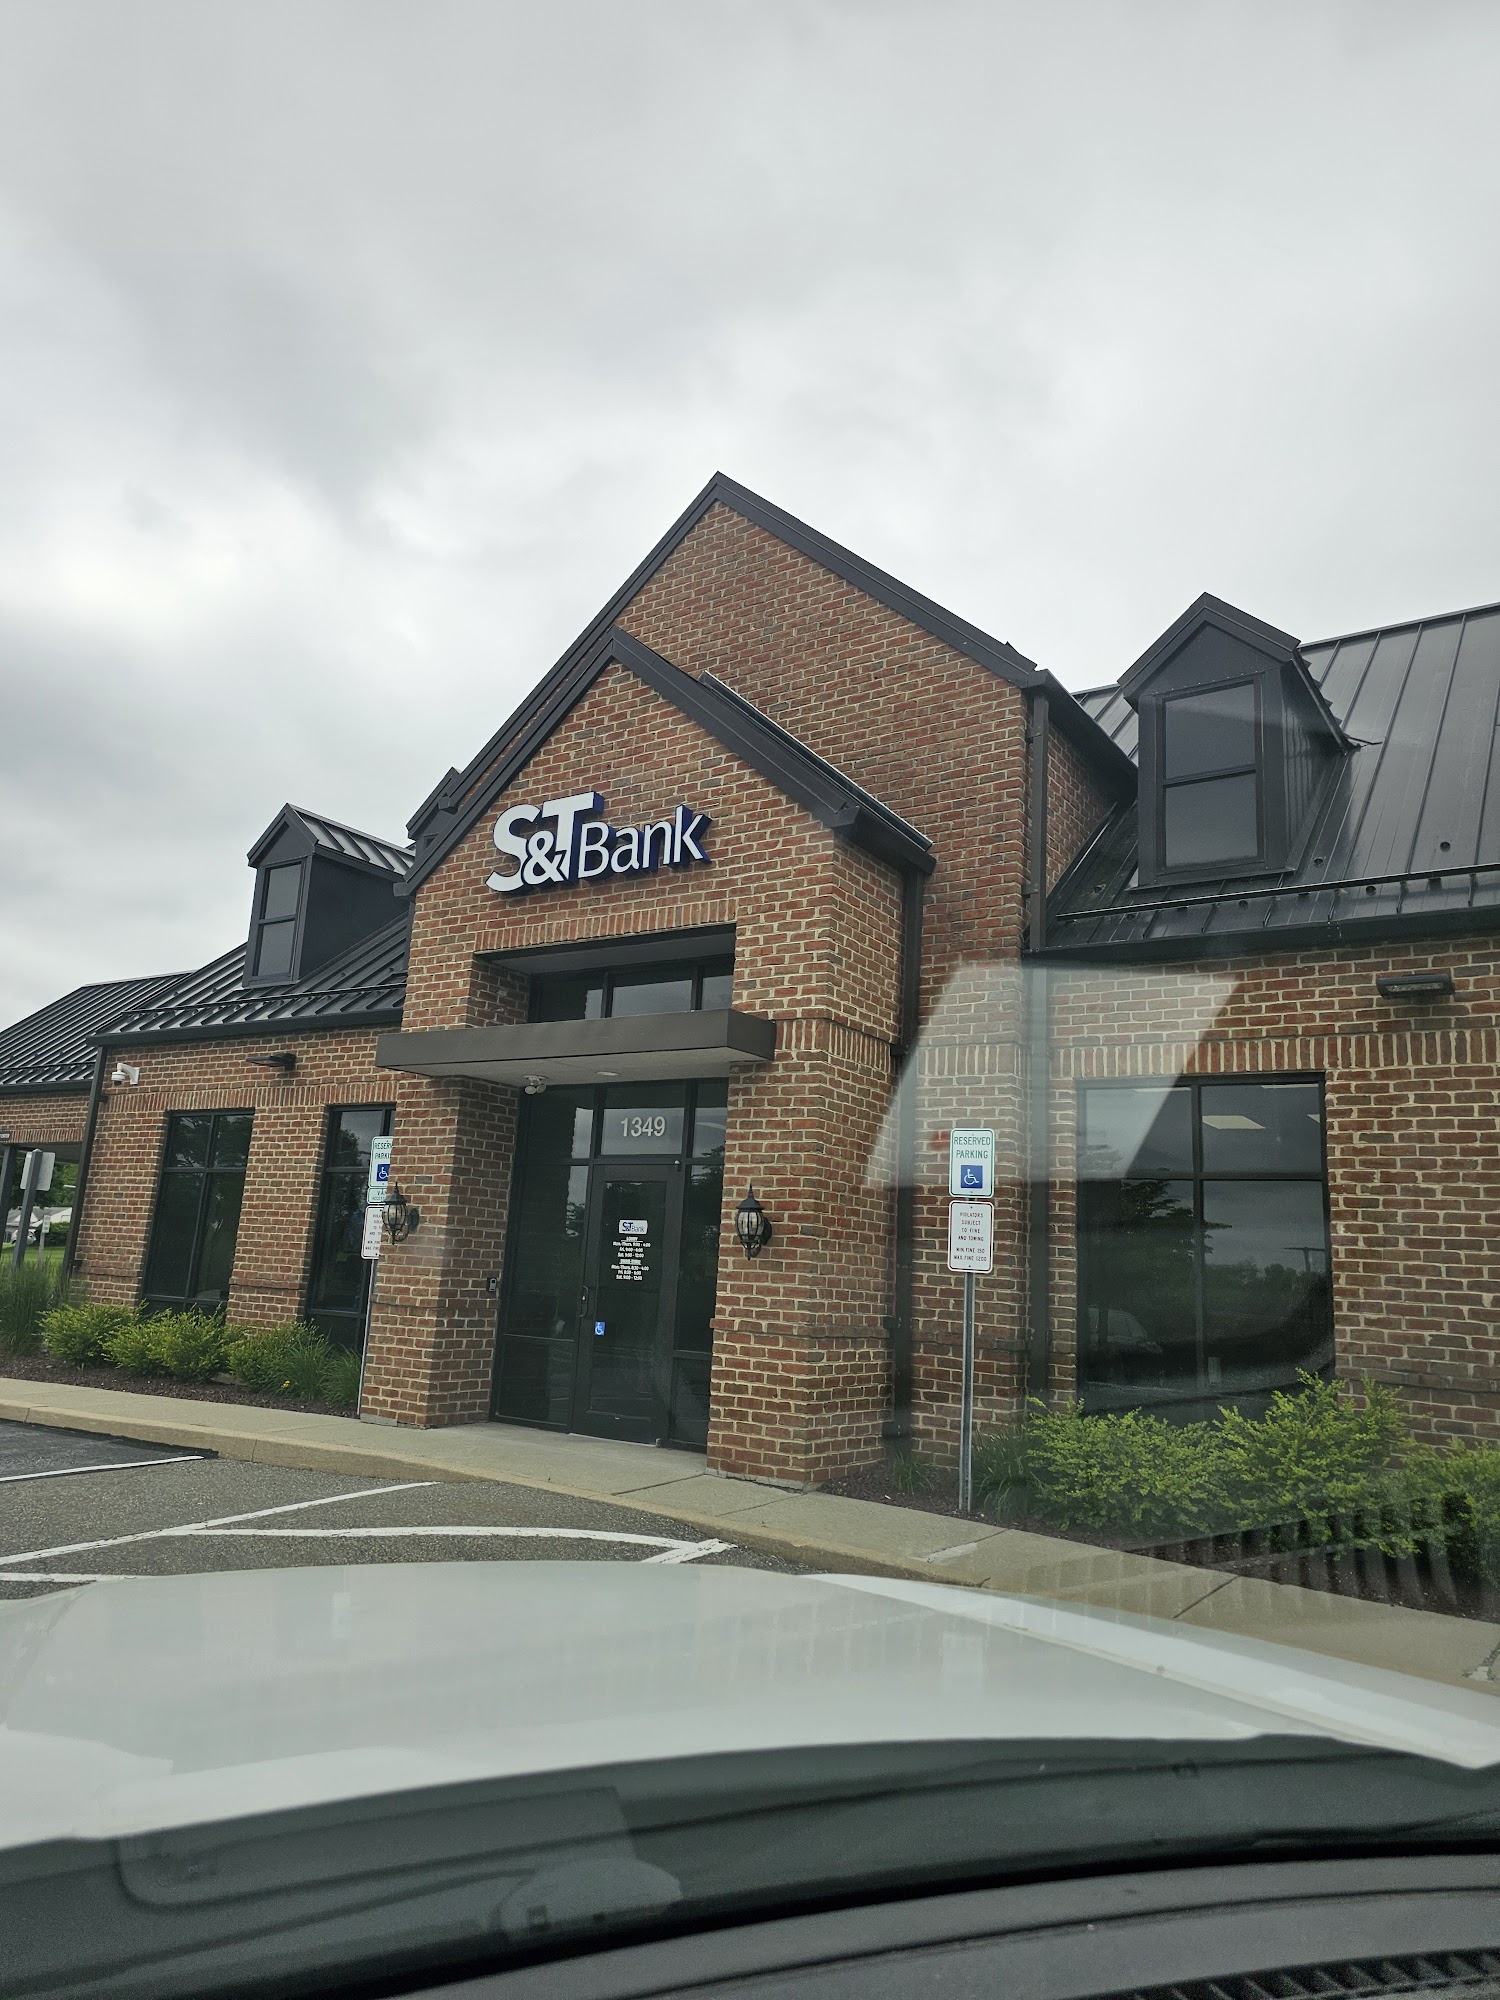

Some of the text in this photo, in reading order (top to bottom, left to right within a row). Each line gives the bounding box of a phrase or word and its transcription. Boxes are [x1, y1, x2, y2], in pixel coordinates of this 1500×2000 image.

[485, 791, 712, 892] S&T Bank
[620, 1116, 666, 1137] 1349
[954, 1136, 991, 1146] RESERVED
[956, 1149, 988, 1159] PARKING
